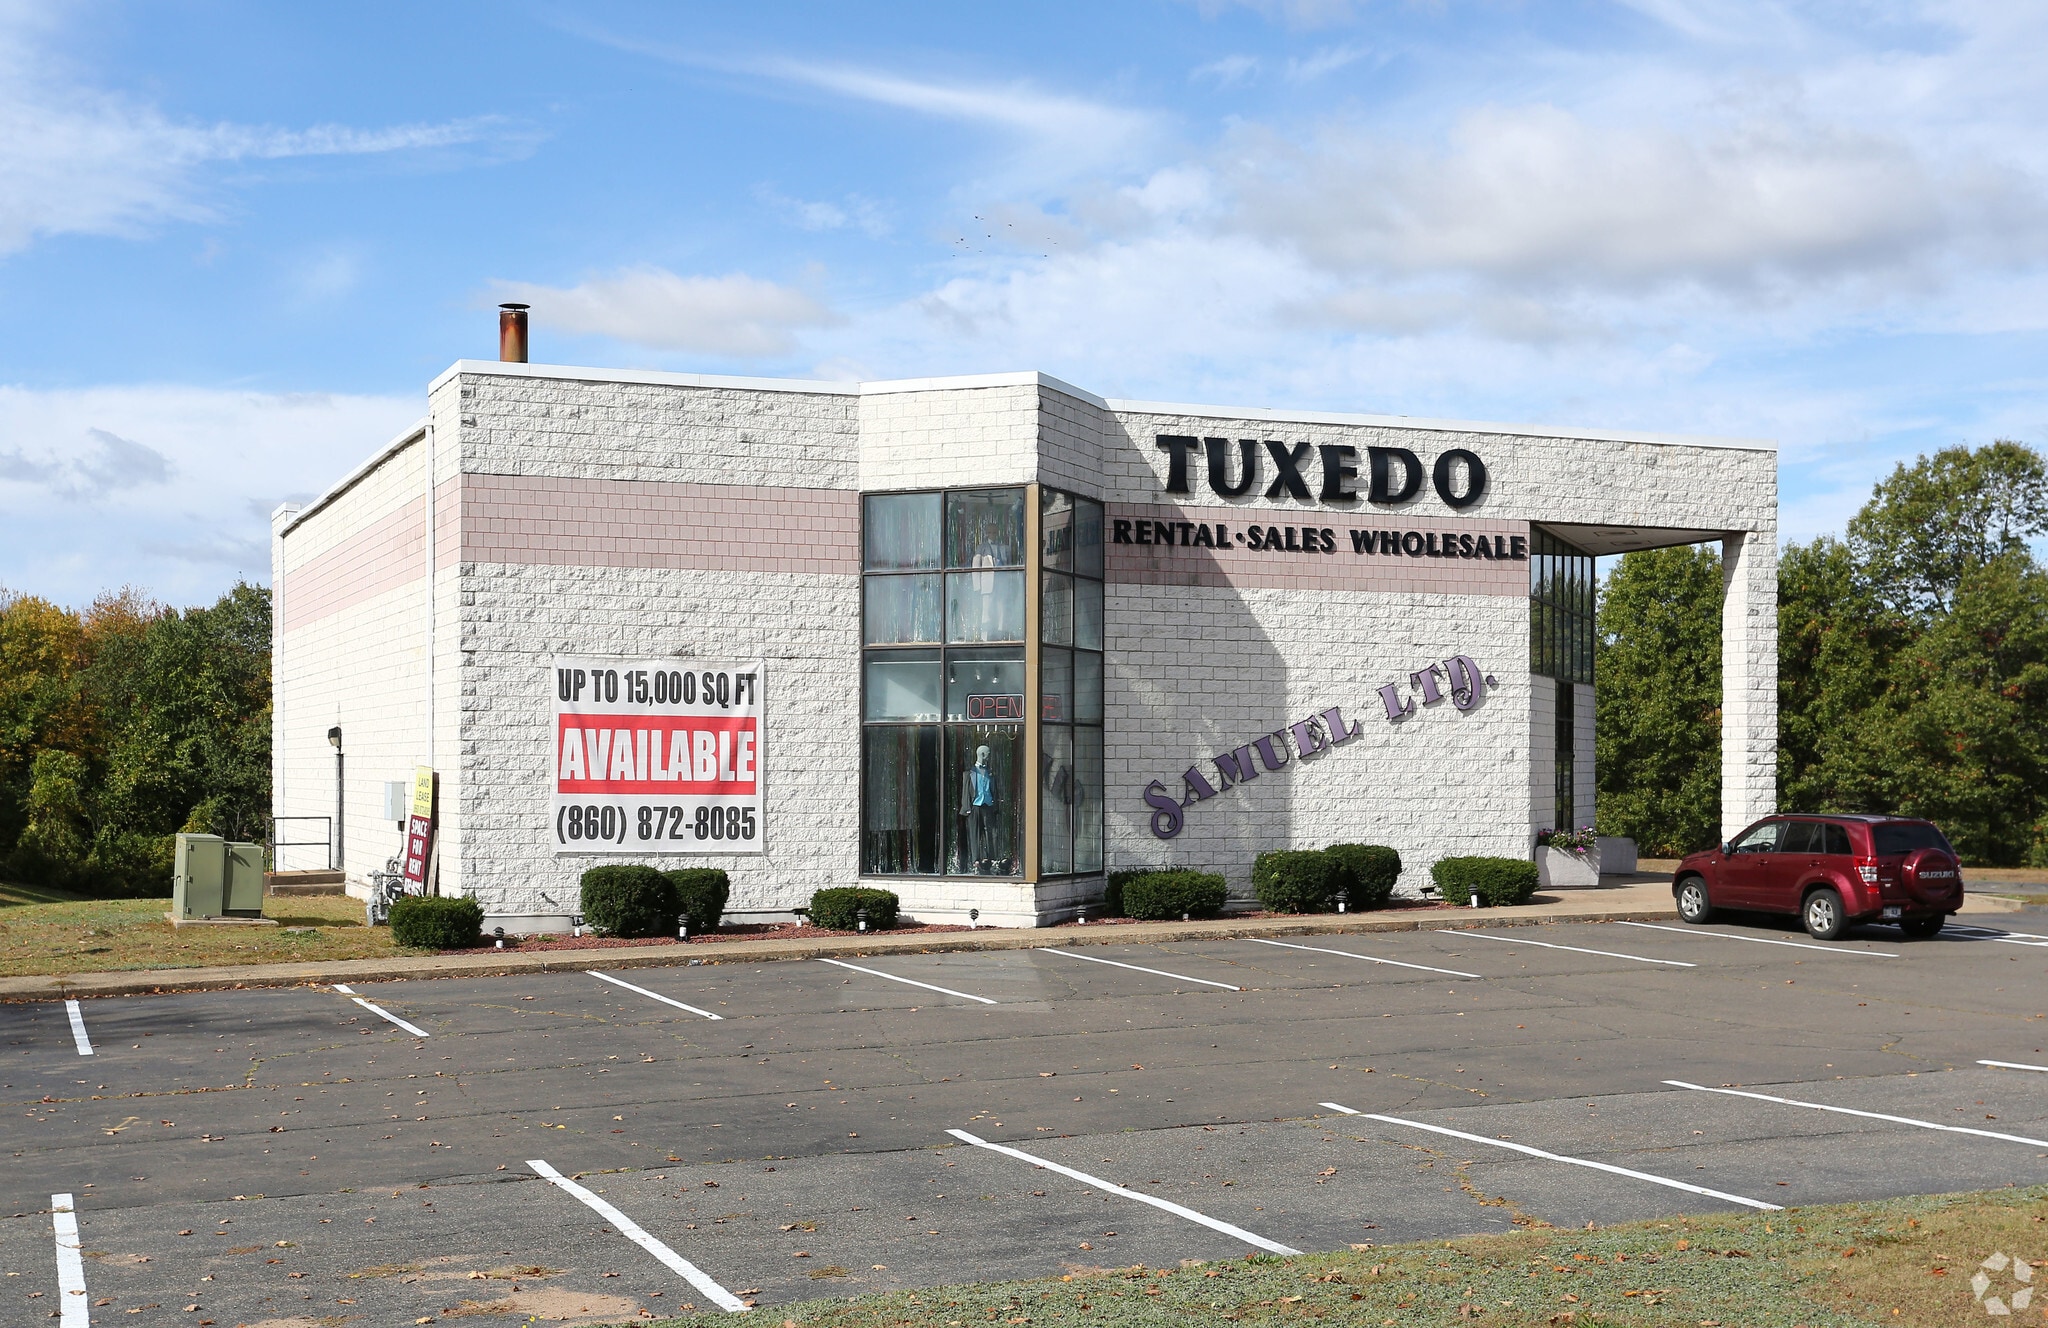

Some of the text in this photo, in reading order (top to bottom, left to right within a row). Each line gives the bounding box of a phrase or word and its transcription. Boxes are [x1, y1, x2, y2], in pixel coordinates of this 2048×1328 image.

[1156, 435, 1487, 507] TUXEDO
[1113, 520, 1233, 549] RENTAL
[1247, 525, 1335, 552] SALES
[1349, 529, 1528, 560] WHOLESALE
[558, 668, 757, 708] UP TO 15,000 SQ FT
[969, 697, 1022, 718] OPEN
[559, 728, 755, 782] AVAILABLE
[1143, 654, 1496, 839] SAMUEL LTD.
[415, 790, 430, 803] LEASE
[411, 818, 428, 838] SPACE
[557, 805, 756, 844] (860) 872-8085
[412, 838, 423, 856] FOR
[408, 857, 422, 877] RENT
[1919, 870, 1954, 879] SUZUKI
